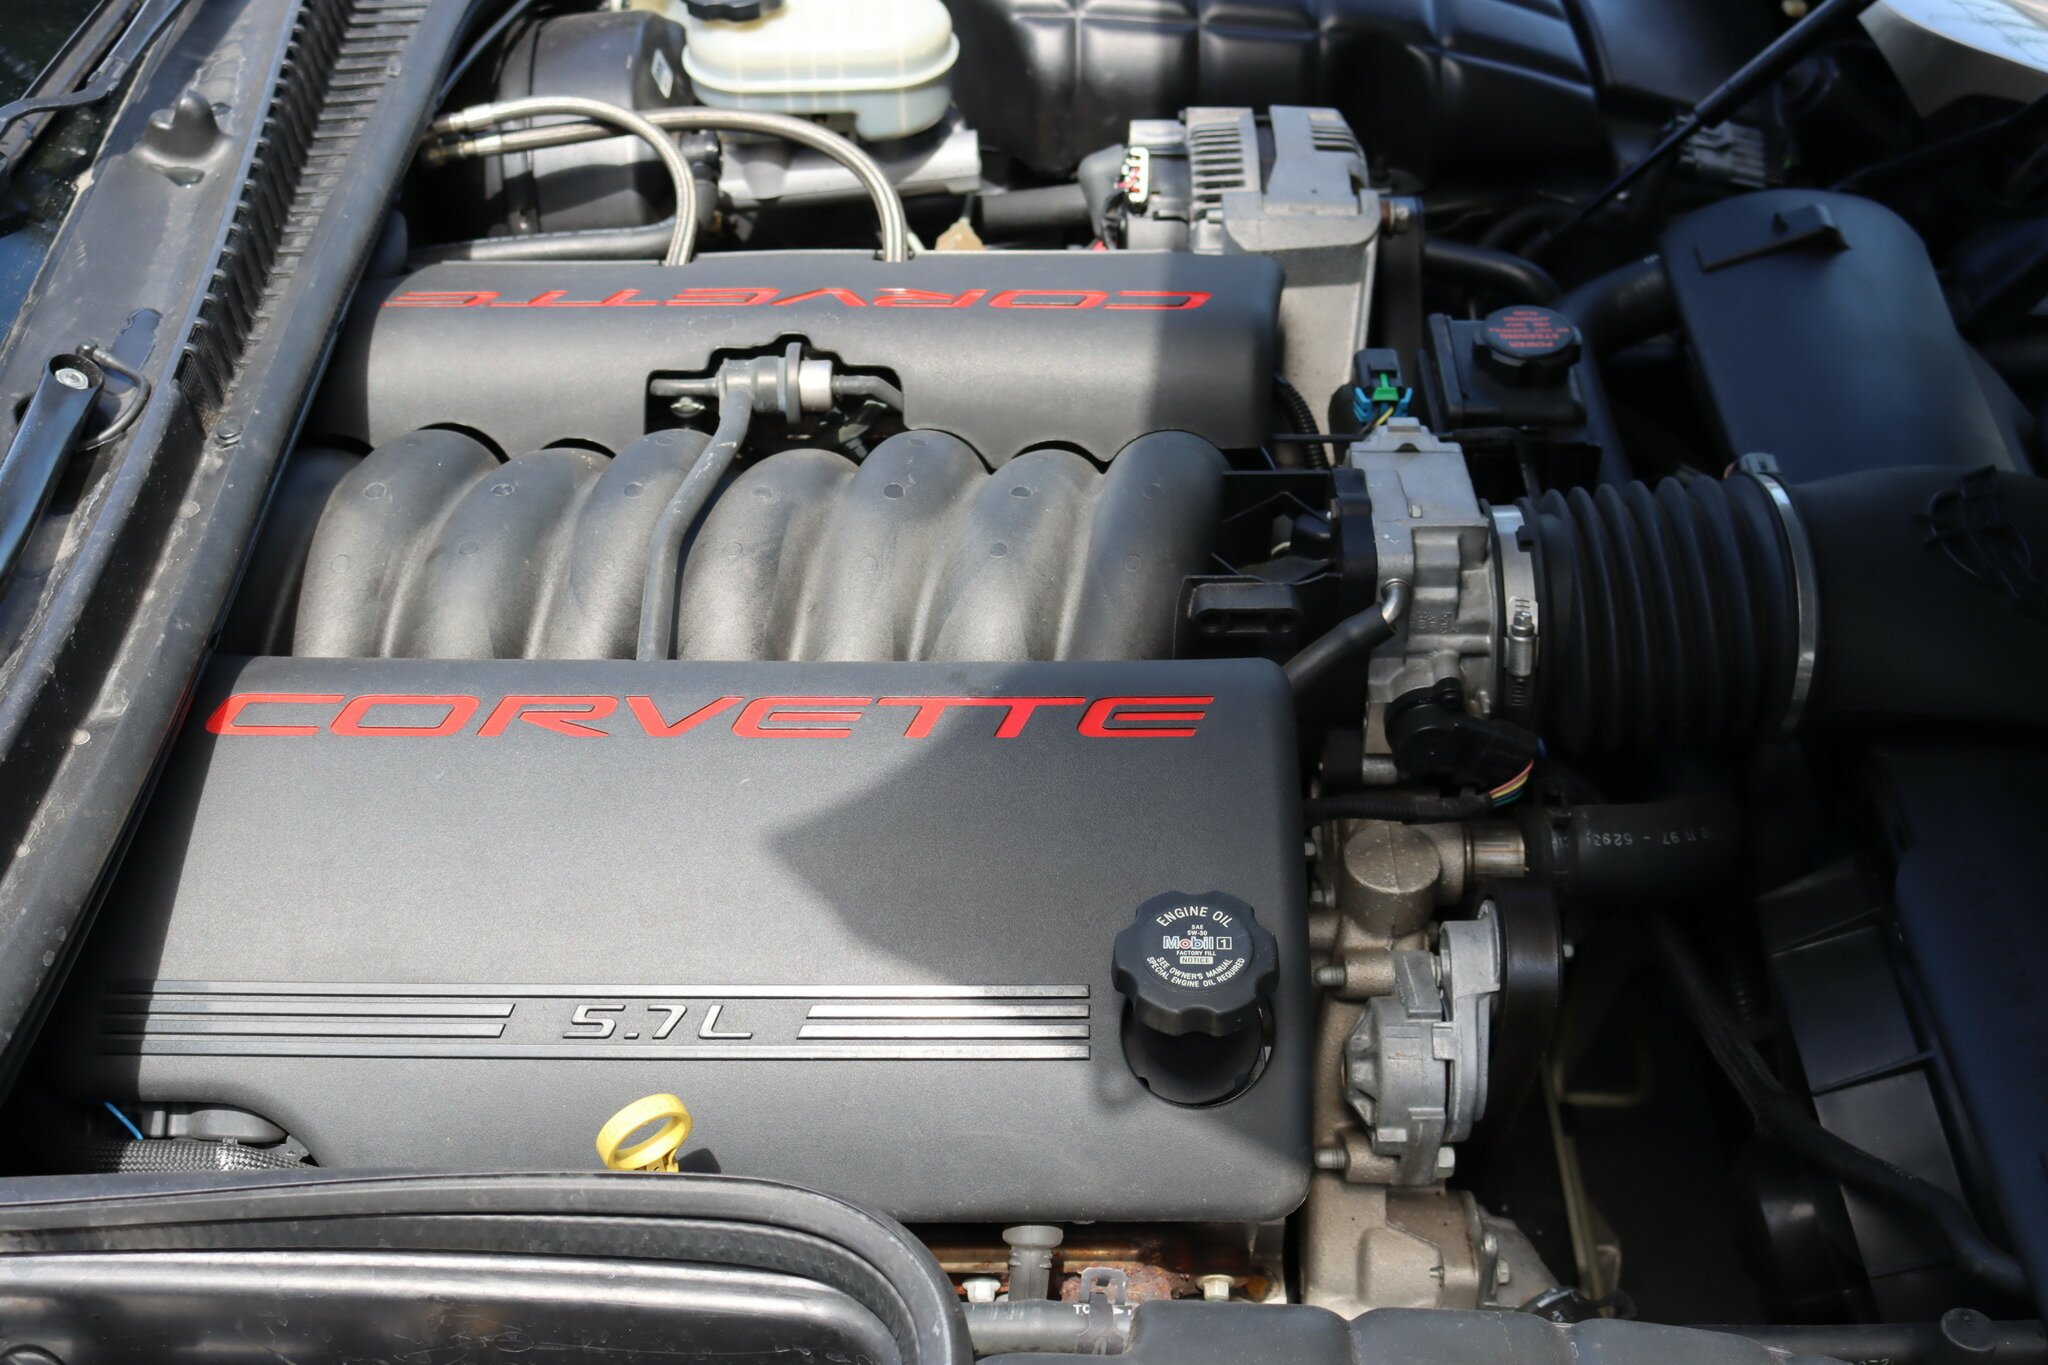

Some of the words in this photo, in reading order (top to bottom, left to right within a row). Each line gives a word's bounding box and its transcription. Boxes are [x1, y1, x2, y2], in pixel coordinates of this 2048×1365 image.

[381, 288, 1213, 310] CORVETTE
[205, 693, 1215, 738] CORVETTE
[1662, 831, 1680, 845] 97
[1156, 905, 1208, 927] ENGINE
[1212, 910, 1233, 928] OIL
[1162, 935, 1213, 949] Mobil
[1147, 955, 1169, 980] SPECIAL
[1170, 975, 1200, 988] ENGINE
[1202, 977, 1216, 988] OIL
[1216, 957, 1245, 984] REQUIRED
[1156, 956, 1170, 970] SEE
[1170, 966, 1203, 980] OWNER'S
[1205, 957, 1233, 978] MANUAL
[563, 1004, 753, 1039] 5.7L
